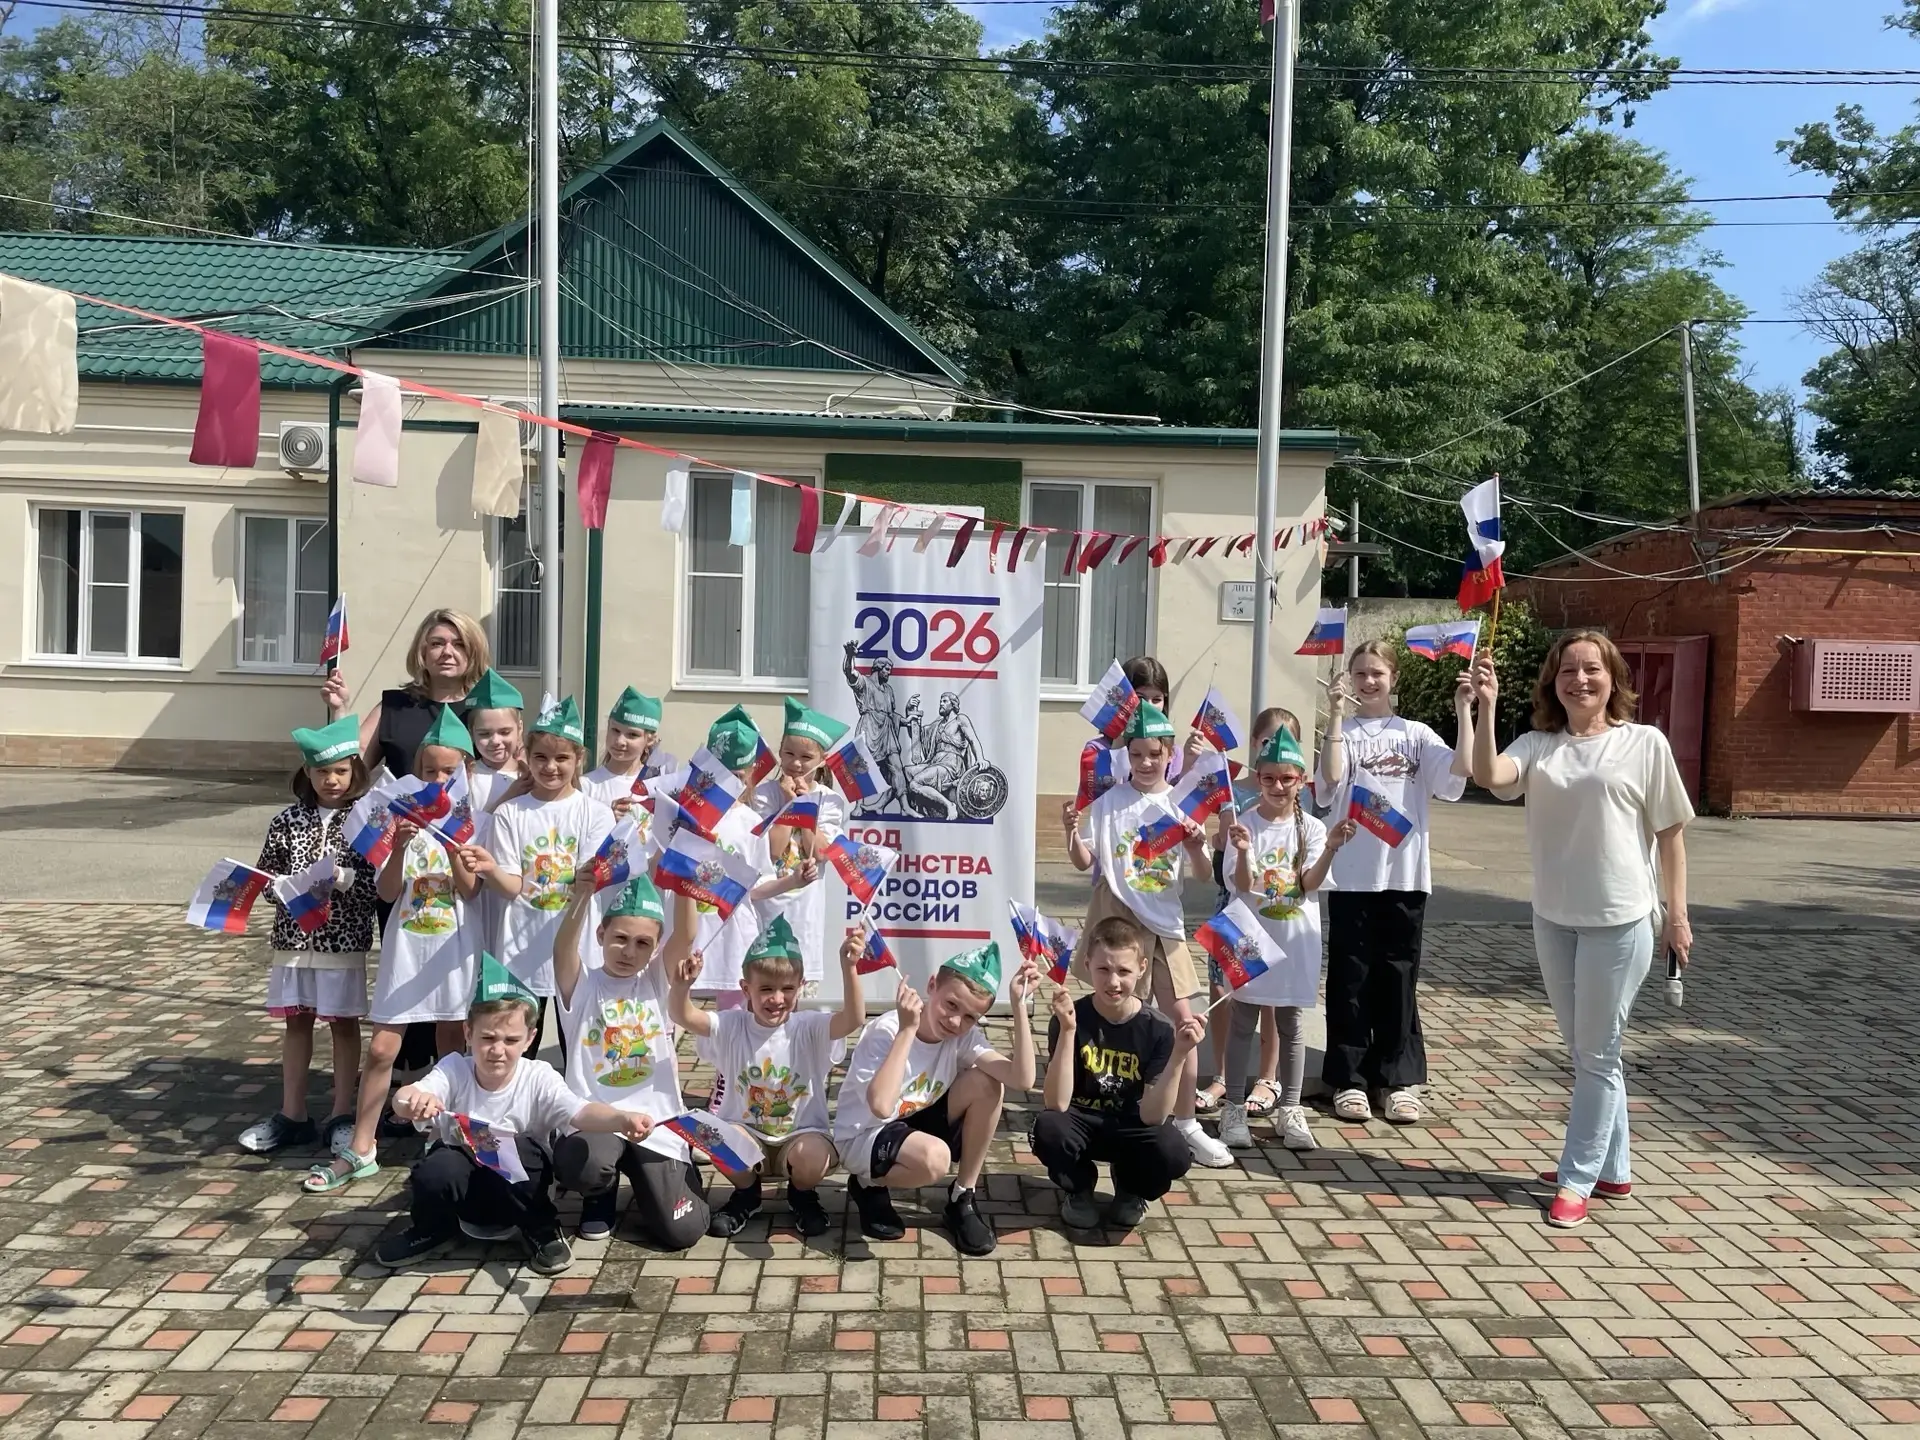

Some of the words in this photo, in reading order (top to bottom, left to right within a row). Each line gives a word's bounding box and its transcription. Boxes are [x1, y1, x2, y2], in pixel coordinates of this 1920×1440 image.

[854, 607, 1000, 664] 2026
[849, 829, 902, 851] ГОД
[896, 854, 992, 875] НСТВА
[847, 878, 978, 900] РОДОВ
[846, 901, 960, 922] РОССИИ
[673, 1200, 694, 1221] UFC
